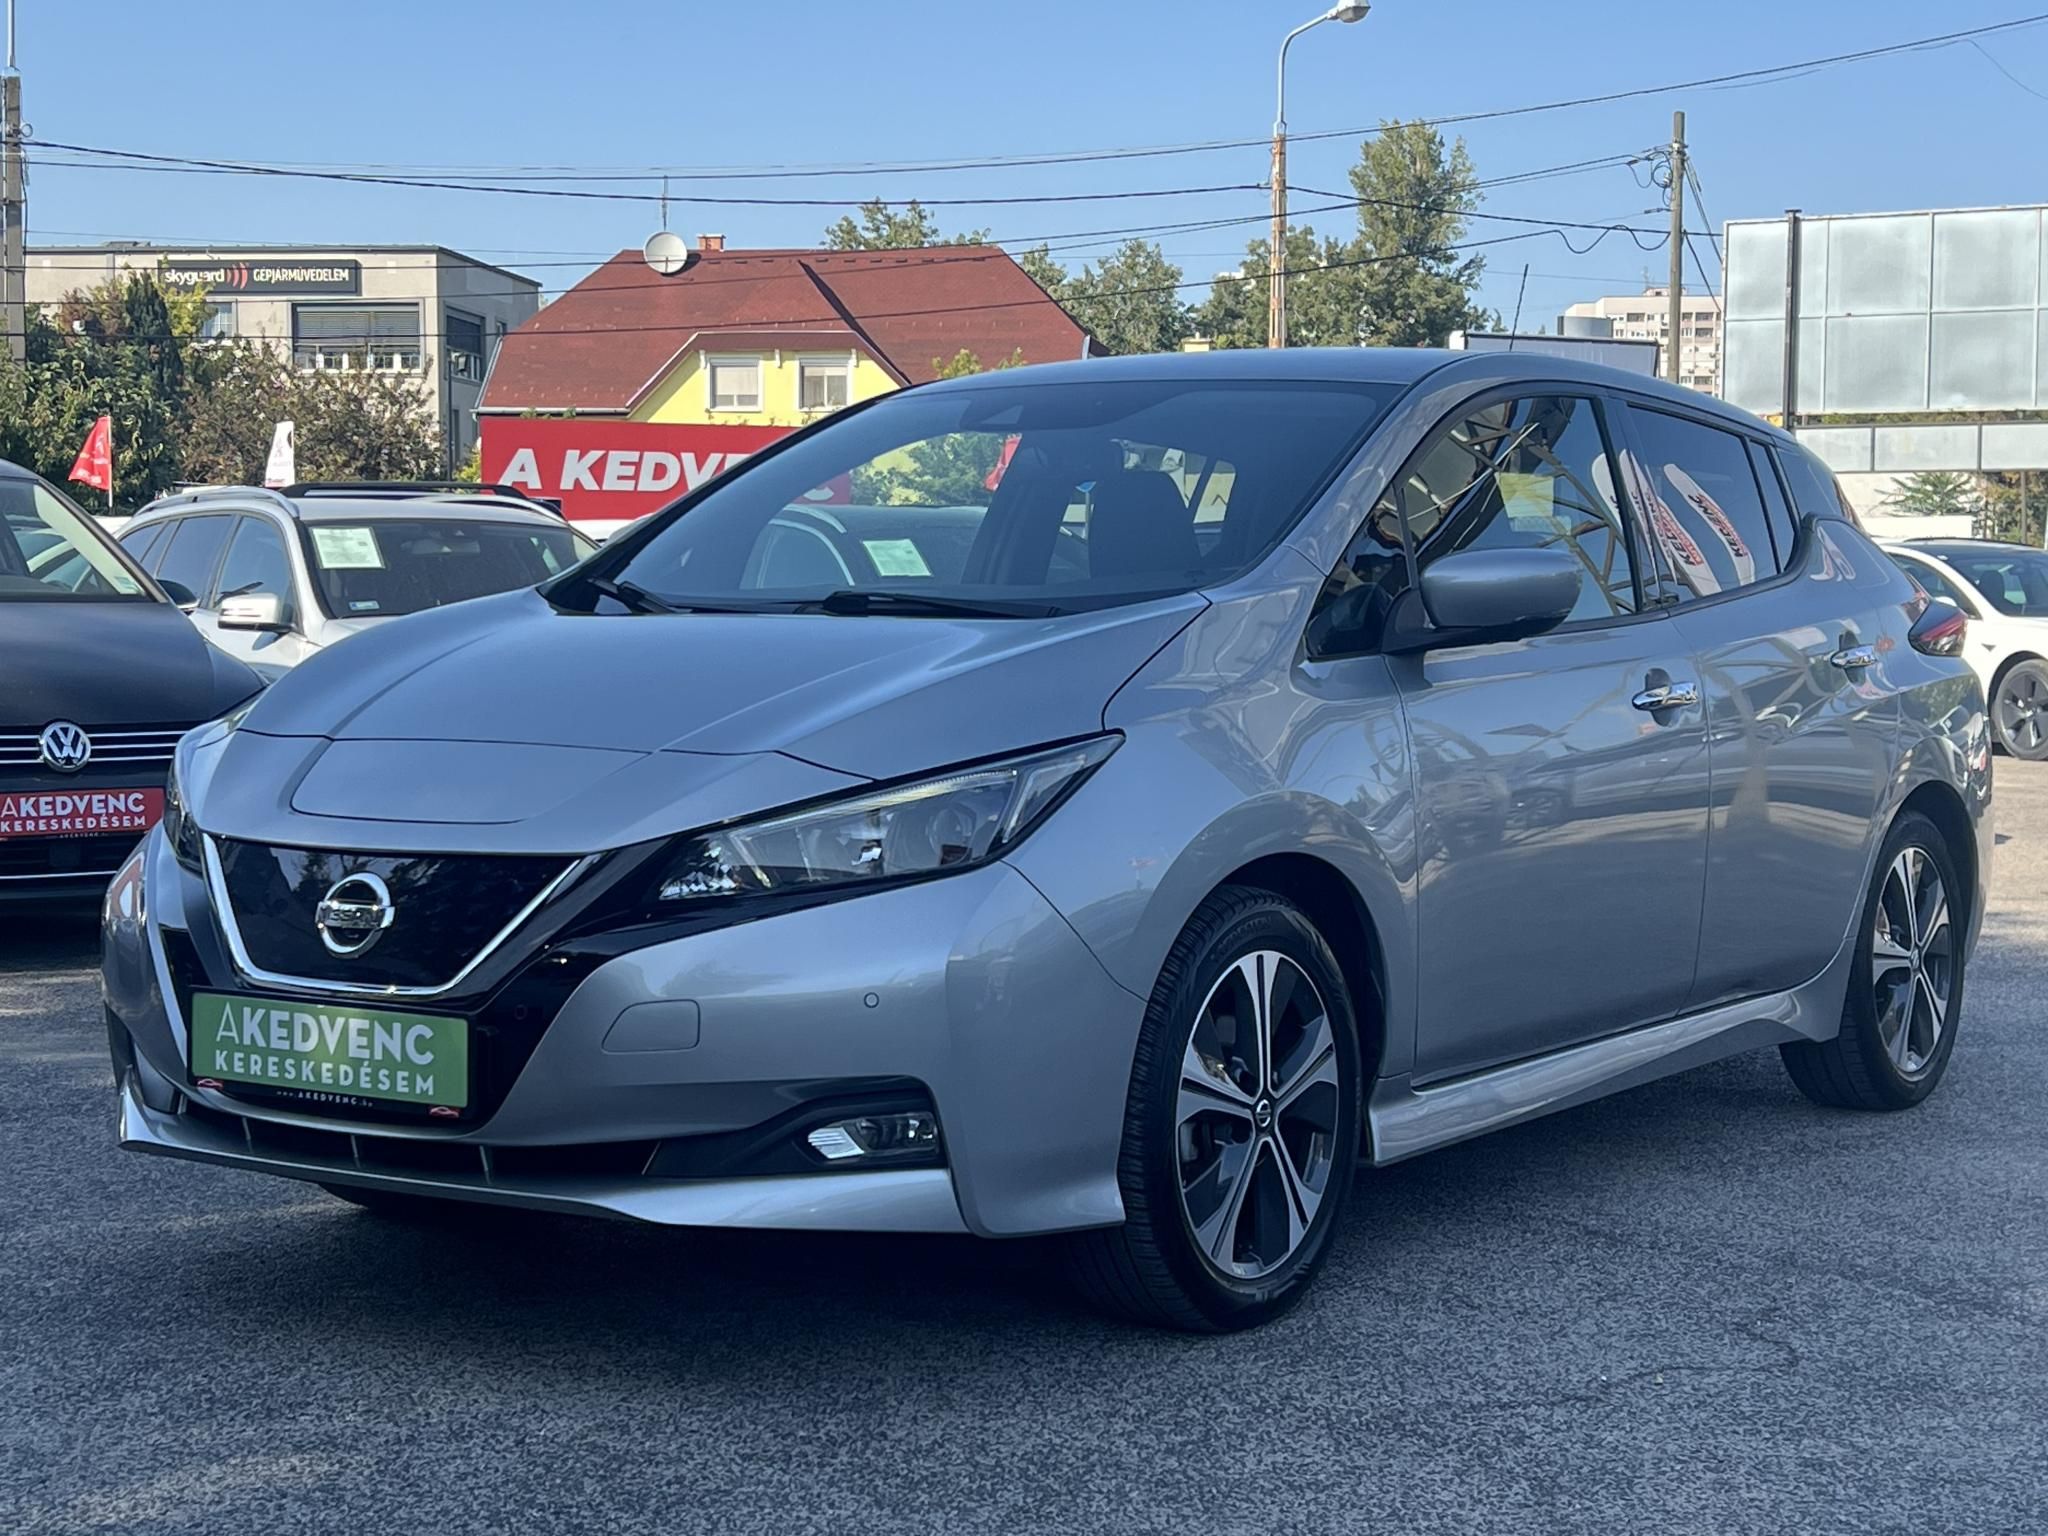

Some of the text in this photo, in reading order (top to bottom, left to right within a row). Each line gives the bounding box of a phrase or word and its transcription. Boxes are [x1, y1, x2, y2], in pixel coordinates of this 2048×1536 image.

[165, 268, 225, 286] skyguard
[497, 448, 752, 492] A KEDV
[1, 814, 146, 832] KERESKEDÉSEM
[215, 1050, 434, 1096] KERESKEDÉSEM
